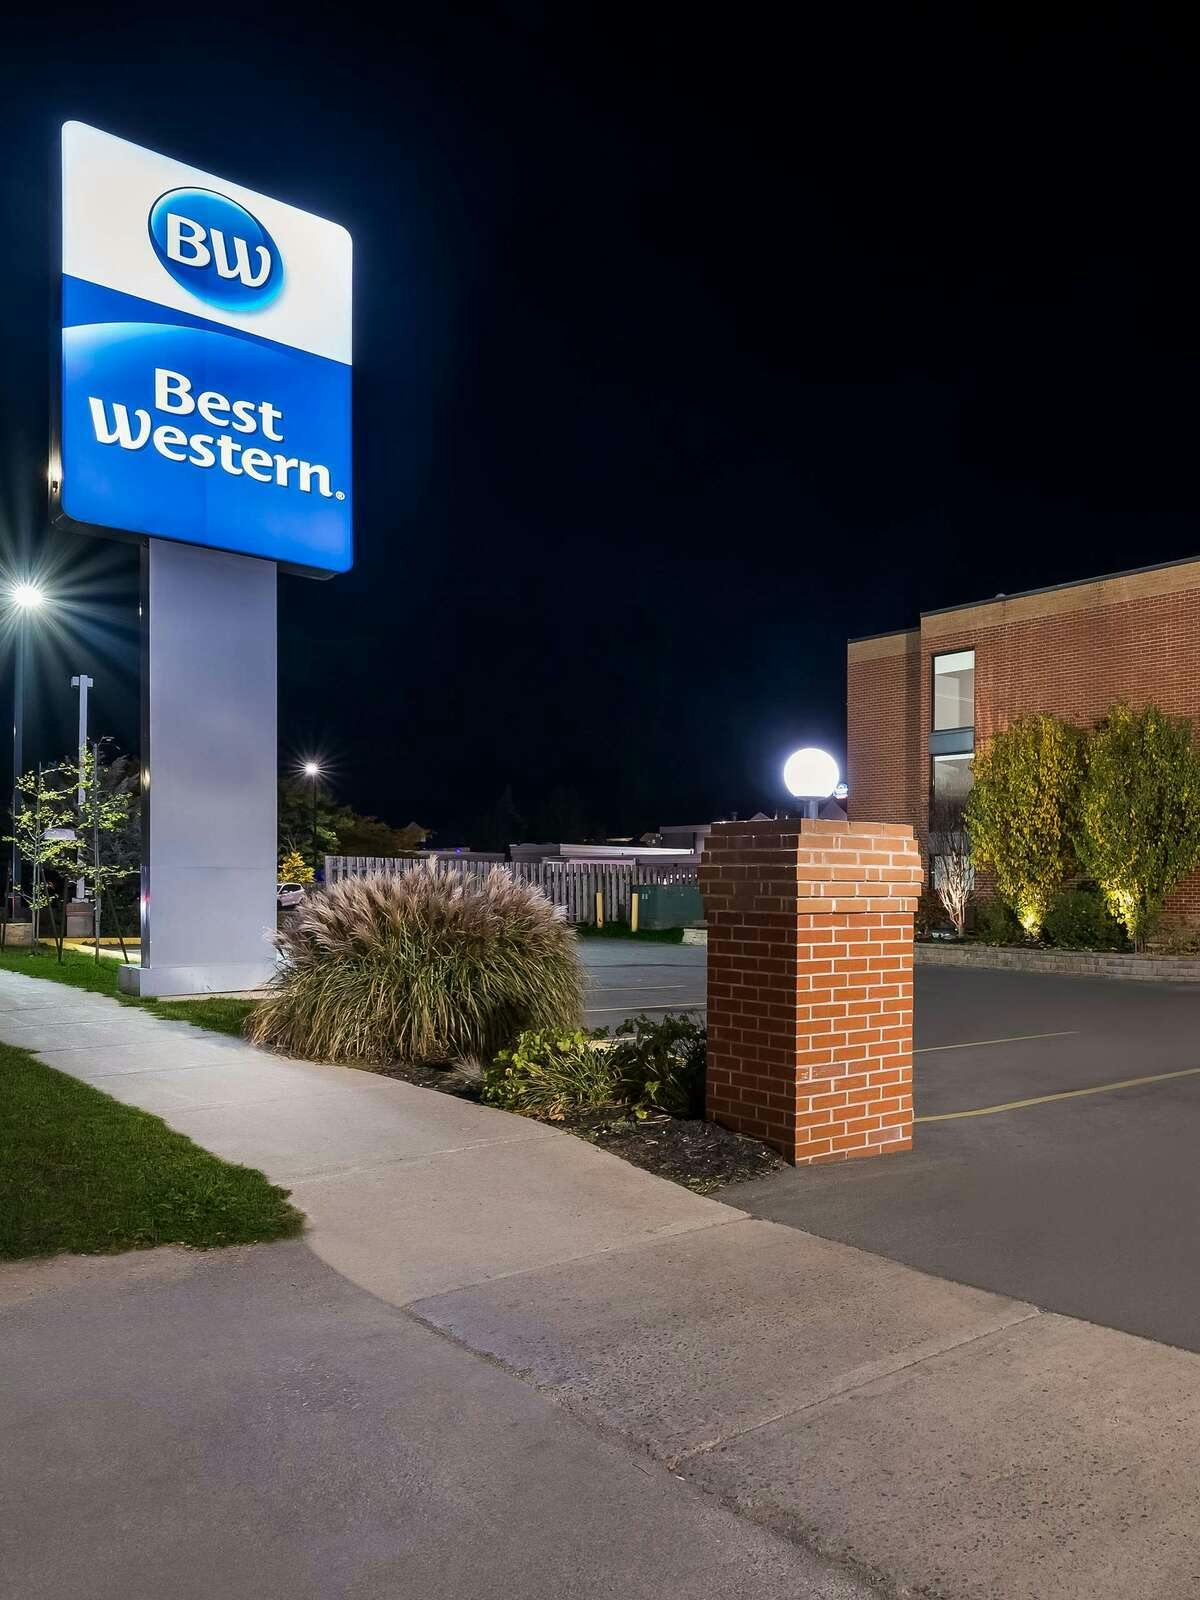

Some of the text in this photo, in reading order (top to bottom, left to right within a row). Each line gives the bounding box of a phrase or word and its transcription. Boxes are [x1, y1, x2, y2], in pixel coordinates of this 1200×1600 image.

[165, 212, 272, 289] BW
[154, 367, 284, 441] Best
[87, 396, 335, 498] Western
